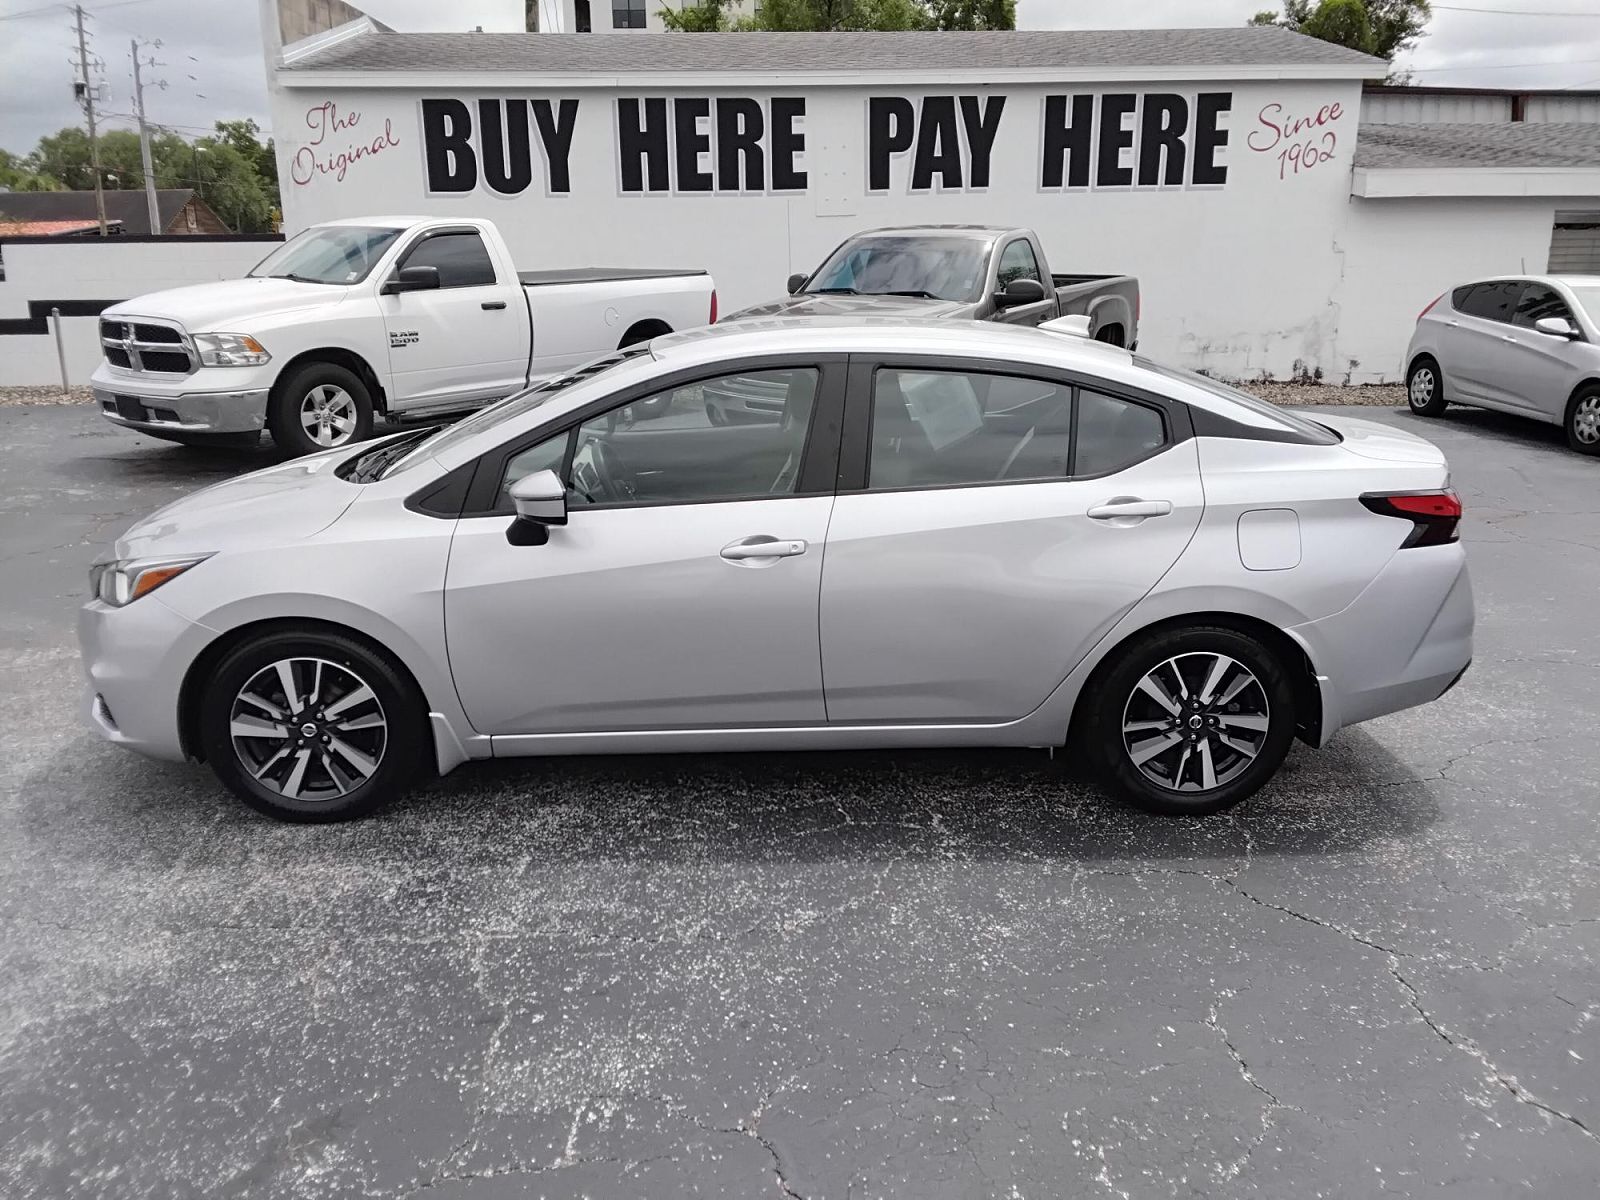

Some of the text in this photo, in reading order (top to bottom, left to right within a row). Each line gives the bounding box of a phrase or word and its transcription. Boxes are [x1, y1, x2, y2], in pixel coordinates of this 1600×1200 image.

[306, 101, 361, 145] The
[420, 92, 1233, 195] BUY HERE PAY HERE
[1247, 102, 1344, 152] Since
[291, 118, 400, 185] Original
[1277, 131, 1336, 180] 1962
